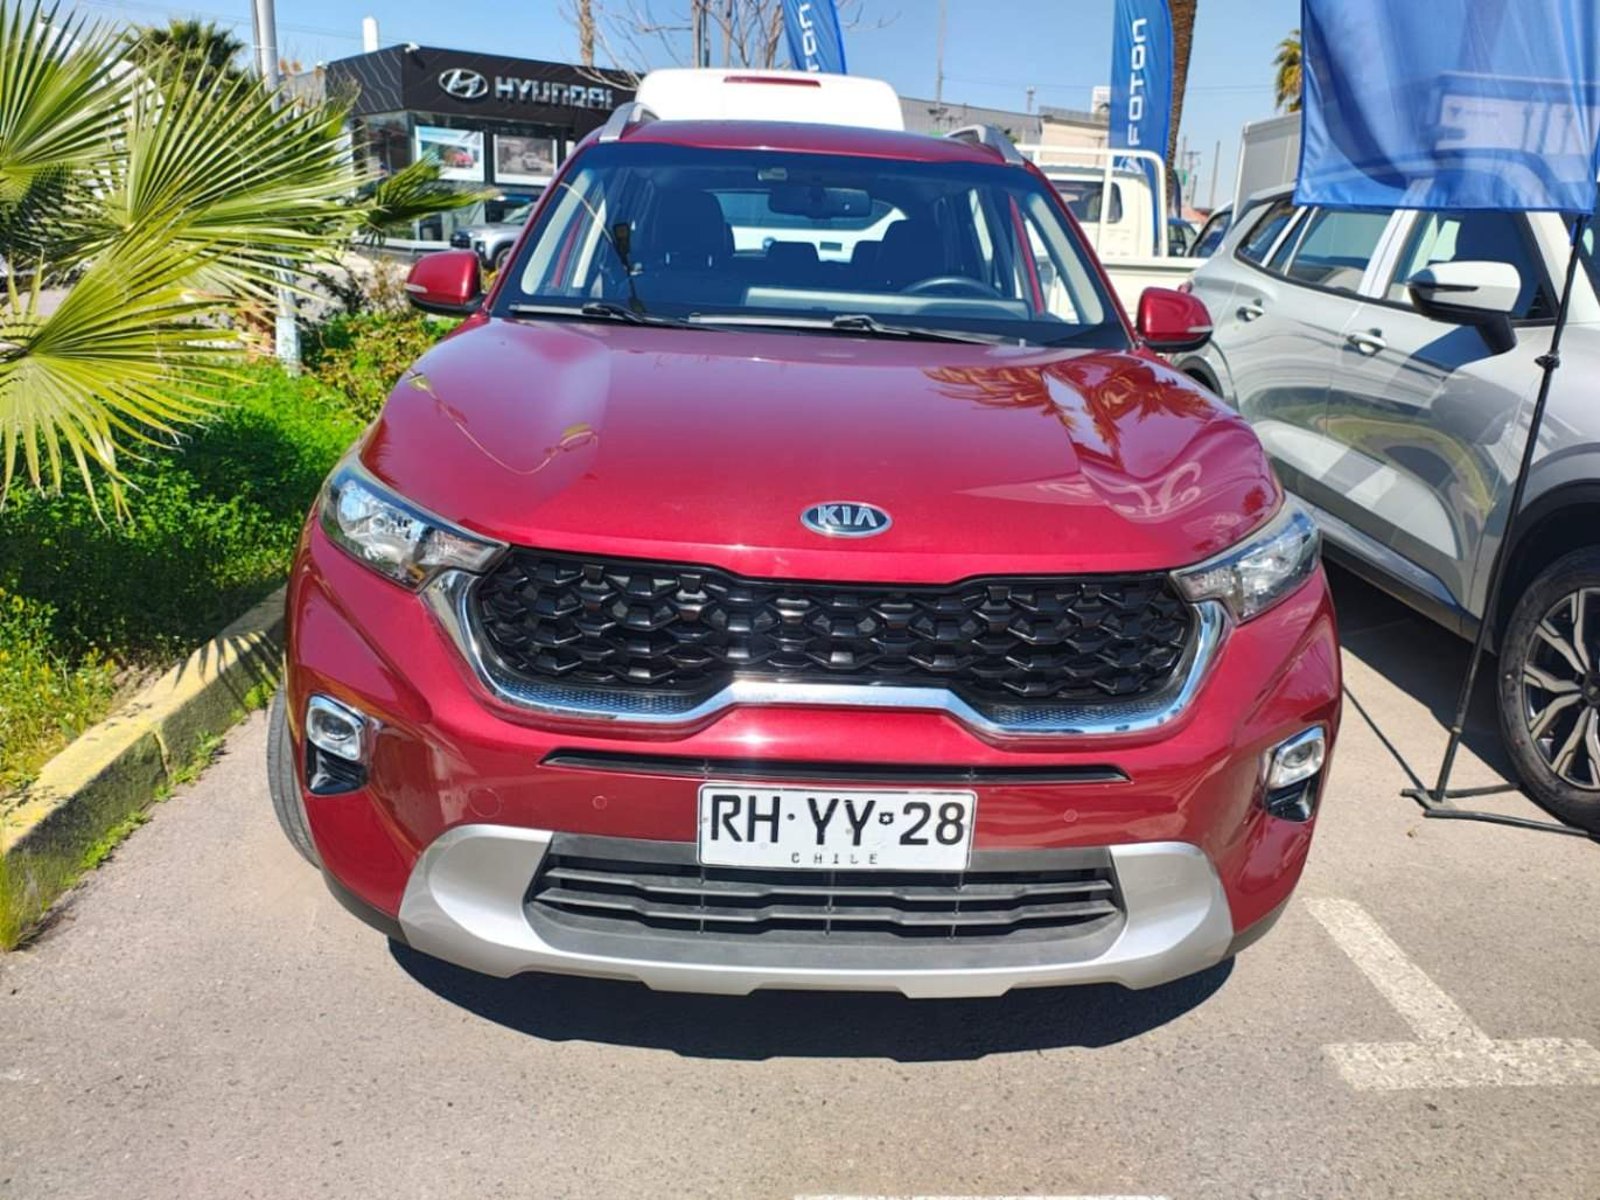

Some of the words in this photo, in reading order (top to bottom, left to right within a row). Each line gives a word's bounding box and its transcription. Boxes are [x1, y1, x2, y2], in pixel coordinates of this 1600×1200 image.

[495, 76, 613, 109] HYUNDAI
[1127, 18, 1147, 146] FOTON
[817, 505, 878, 527] KIA
[790, 851, 879, 865] CHILE
